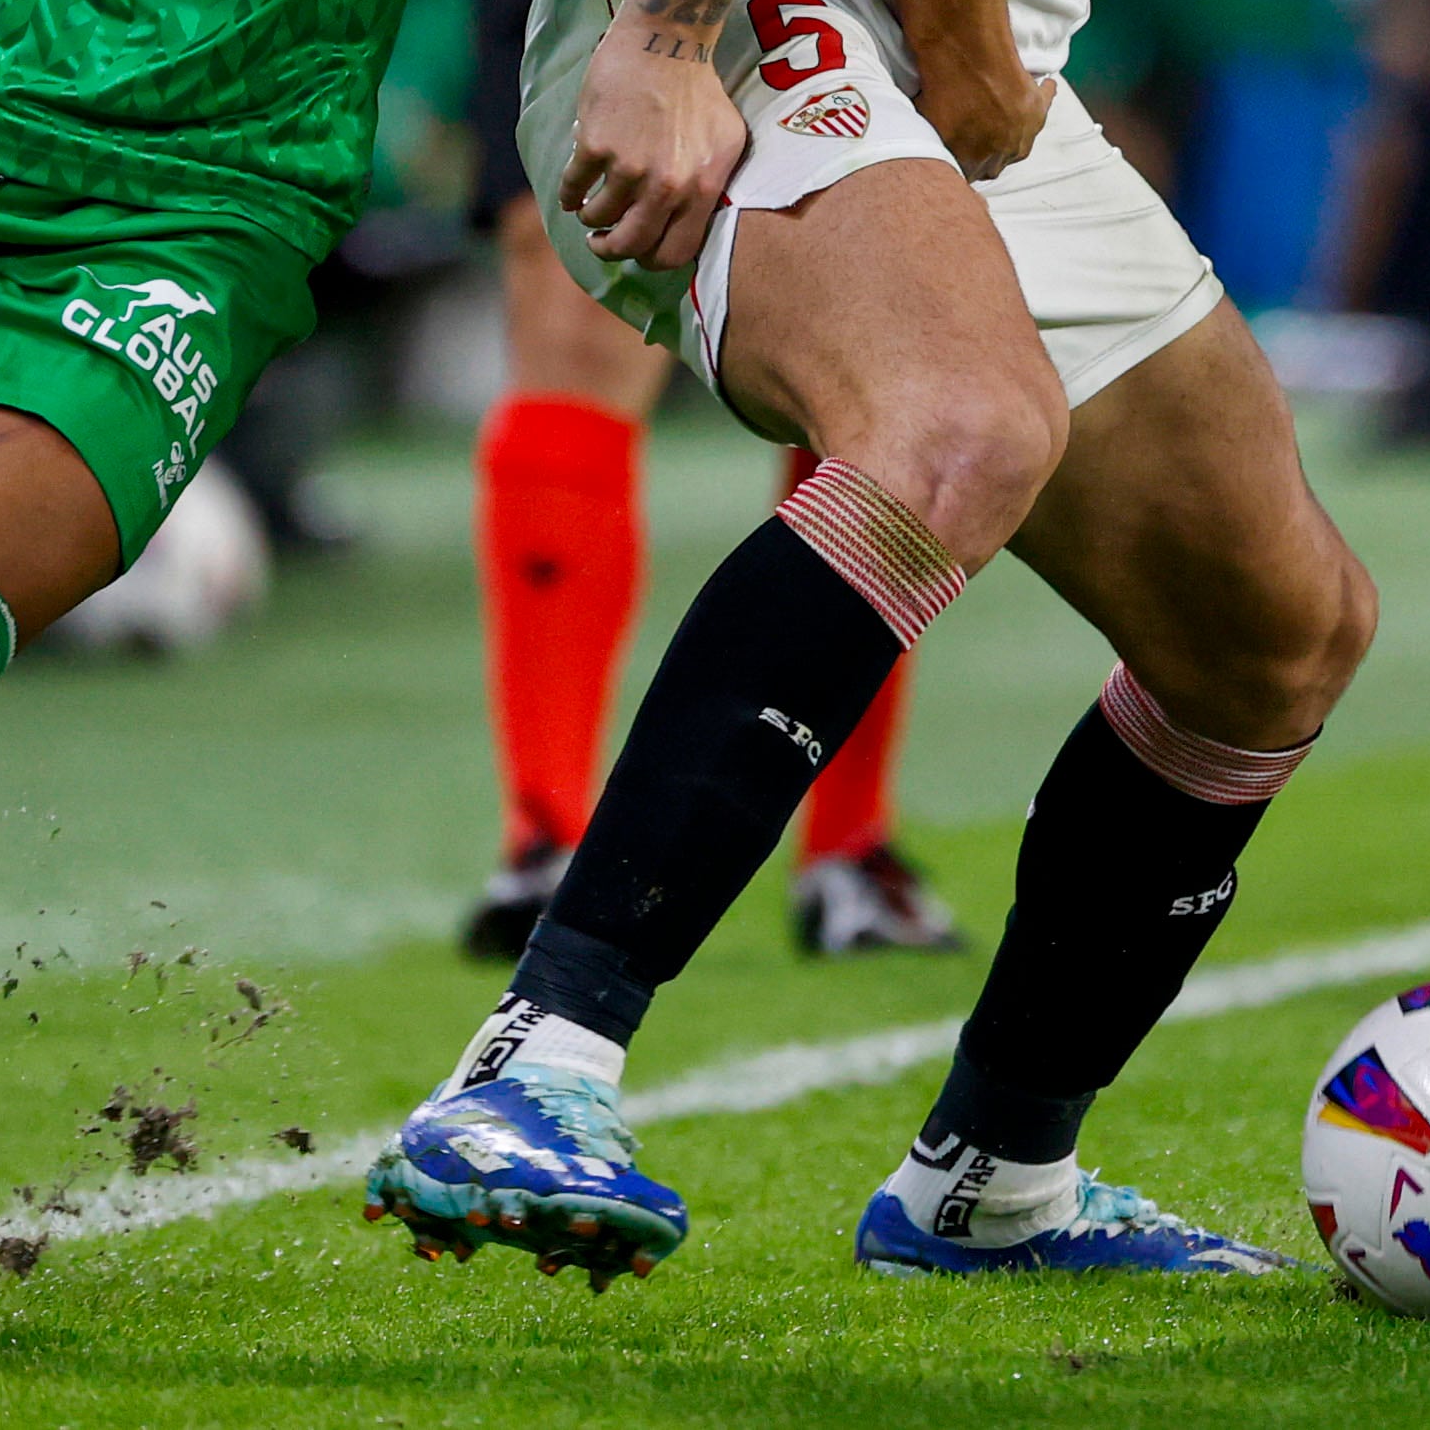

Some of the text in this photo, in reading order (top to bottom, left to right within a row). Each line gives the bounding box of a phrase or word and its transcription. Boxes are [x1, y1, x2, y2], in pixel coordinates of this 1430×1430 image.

[61, 298, 205, 460] GLOBAL
[139, 313, 218, 404] AUS
[757, 706, 822, 767] SFC
[1167, 870, 1233, 916] SFC
